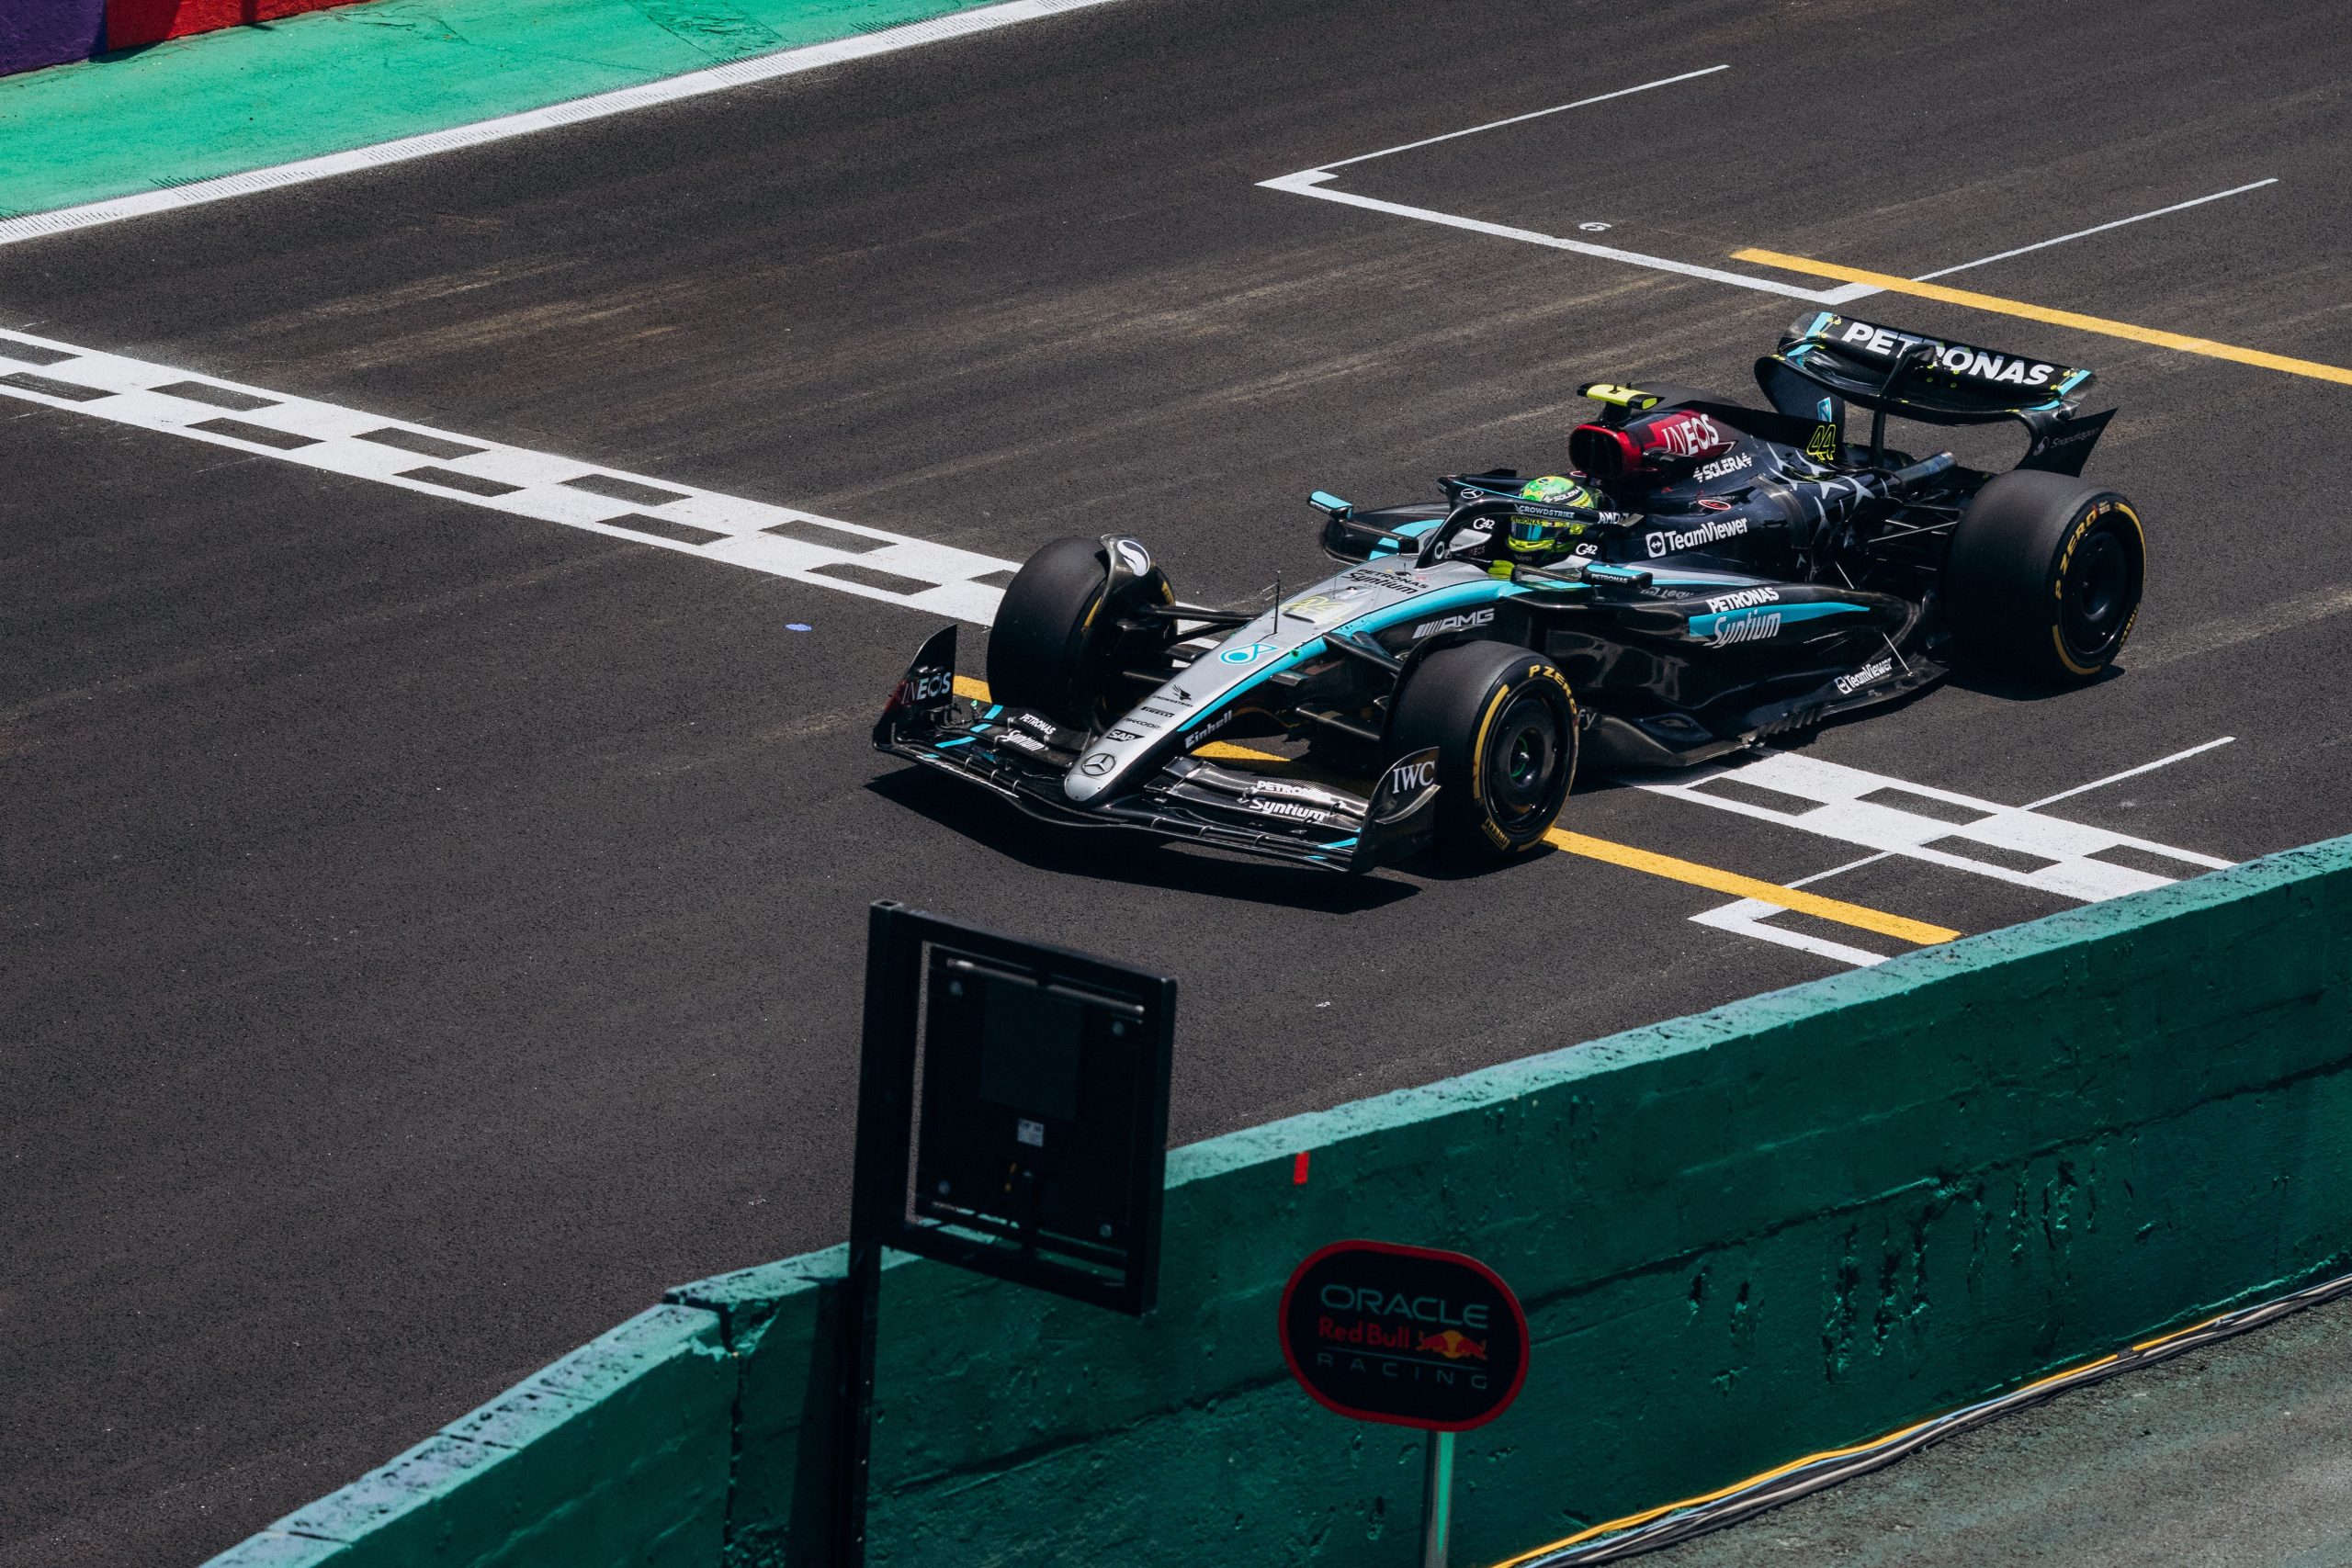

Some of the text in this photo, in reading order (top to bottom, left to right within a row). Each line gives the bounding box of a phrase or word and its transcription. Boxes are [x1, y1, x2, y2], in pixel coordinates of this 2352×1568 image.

[1661, 413, 1719, 456] INEOS
[1807, 424, 1836, 461] 44
[1702, 456, 1747, 480] SOLERA
[1473, 517, 1496, 530] G42
[1519, 505, 1576, 519] CROWDSTRIKE
[1664, 517, 1747, 551] TeamViewer
[2059, 508, 2098, 576] ZERO
[1575, 543, 1599, 556] G42
[1341, 572, 1419, 594] Syntium
[1357, 569, 1430, 589] PETRONAS
[1591, 573, 1629, 584] PETRONAS
[1705, 587, 1780, 614] PETRONAS
[1435, 608, 1495, 632] AMG
[1702, 609, 1781, 649] Syntium
[1845, 657, 1893, 688] TeamViewer
[902, 671, 952, 705] INEOS
[1543, 666, 1578, 715] ZERO
[1019, 713, 1057, 736] PETRONAS
[1140, 705, 1176, 718] PIRELLI
[1001, 729, 1046, 751] Syntium
[1108, 729, 1137, 742] SAP
[1184, 710, 1233, 750] Einhell
[1392, 761, 1435, 795] IWC
[1249, 797, 1327, 822] Syntium
[1319, 1284, 1489, 1330] ORACLE
[1317, 1315, 1411, 1348] Red Bull
[1317, 1352, 1488, 1391] RACING
